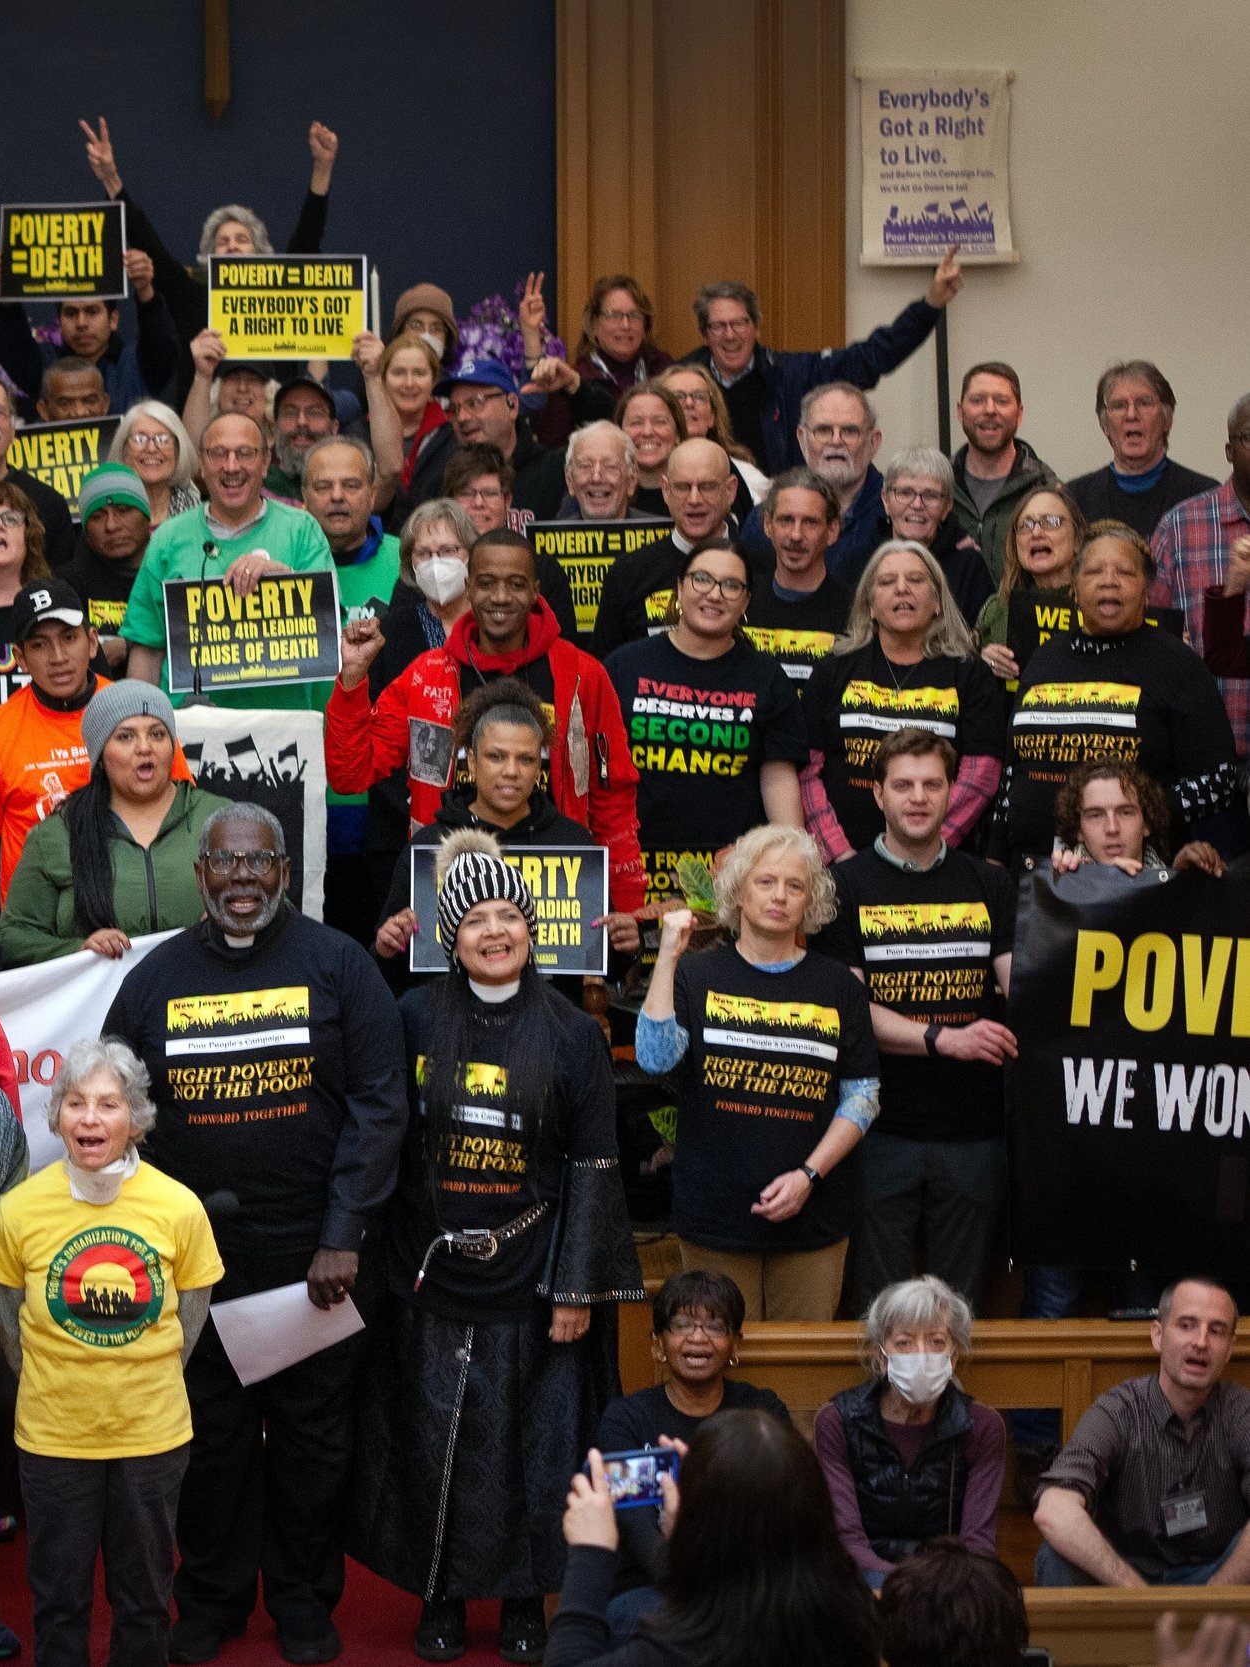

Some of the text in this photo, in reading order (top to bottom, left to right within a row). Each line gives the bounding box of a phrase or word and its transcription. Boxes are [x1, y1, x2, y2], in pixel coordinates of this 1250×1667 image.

[878, 87, 990, 112] Everybody's
[879, 116, 985, 140] Got a Right
[880, 146, 947, 165] to Live.
[9, 211, 105, 246] POVERTY
[218, 264, 284, 287] POVERTY
[303, 264, 353, 287] DEATH
[222, 296, 351, 315] EVERYBODY'S GOT
[229, 317, 344, 336] A RIGHT TO LIVE
[6, 427, 99, 471] OVERTY
[535, 530, 604, 555] POVERTY
[186, 578, 313, 624] POVERTY
[207, 624, 230, 641] the
[235, 621, 258, 640] 4th
[262, 617, 317, 637] LEADING
[191, 637, 319, 667] CAUSE OF DEATH
[638, 677, 757, 708] EVERYONE
[633, 697, 754, 723] DESERVES A
[631, 716, 750, 750] SECOND
[1013, 733, 1142, 750] FIGHT POVERTY
[632, 745, 749, 777] CHANCE
[1019, 748, 1045, 761] NOT
[1049, 747, 1079, 762] THE
[537, 922, 582, 946] EATH
[870, 968, 987, 988] FIGHT POVERTY
[173, 999, 229, 1010] New Jersey
[873, 987, 907, 1002] NOT
[910, 986, 943, 1001] THE
[188, 1034, 285, 1051] Poor People's Campaign
[726, 1034, 820, 1054] Poor People's Campaign
[167, 1056, 316, 1085] FIGHT POVERTY
[703, 1055, 832, 1087] FIGHT POVERTY
[704, 1070, 741, 1089] NOT
[744, 1075, 778, 1095] THE
[173, 1083, 209, 1101] NOT
[214, 1080, 252, 1100] THE
[1062, 1057, 1138, 1129] WE
[188, 1110, 240, 1125] FORWARD
[450, 1150, 480, 1170] THE
[64, 1230, 129, 1260] ORGANIZATION
[130, 1238, 148, 1256] FOR
[64, 1318, 126, 1345] POWER TO THE
